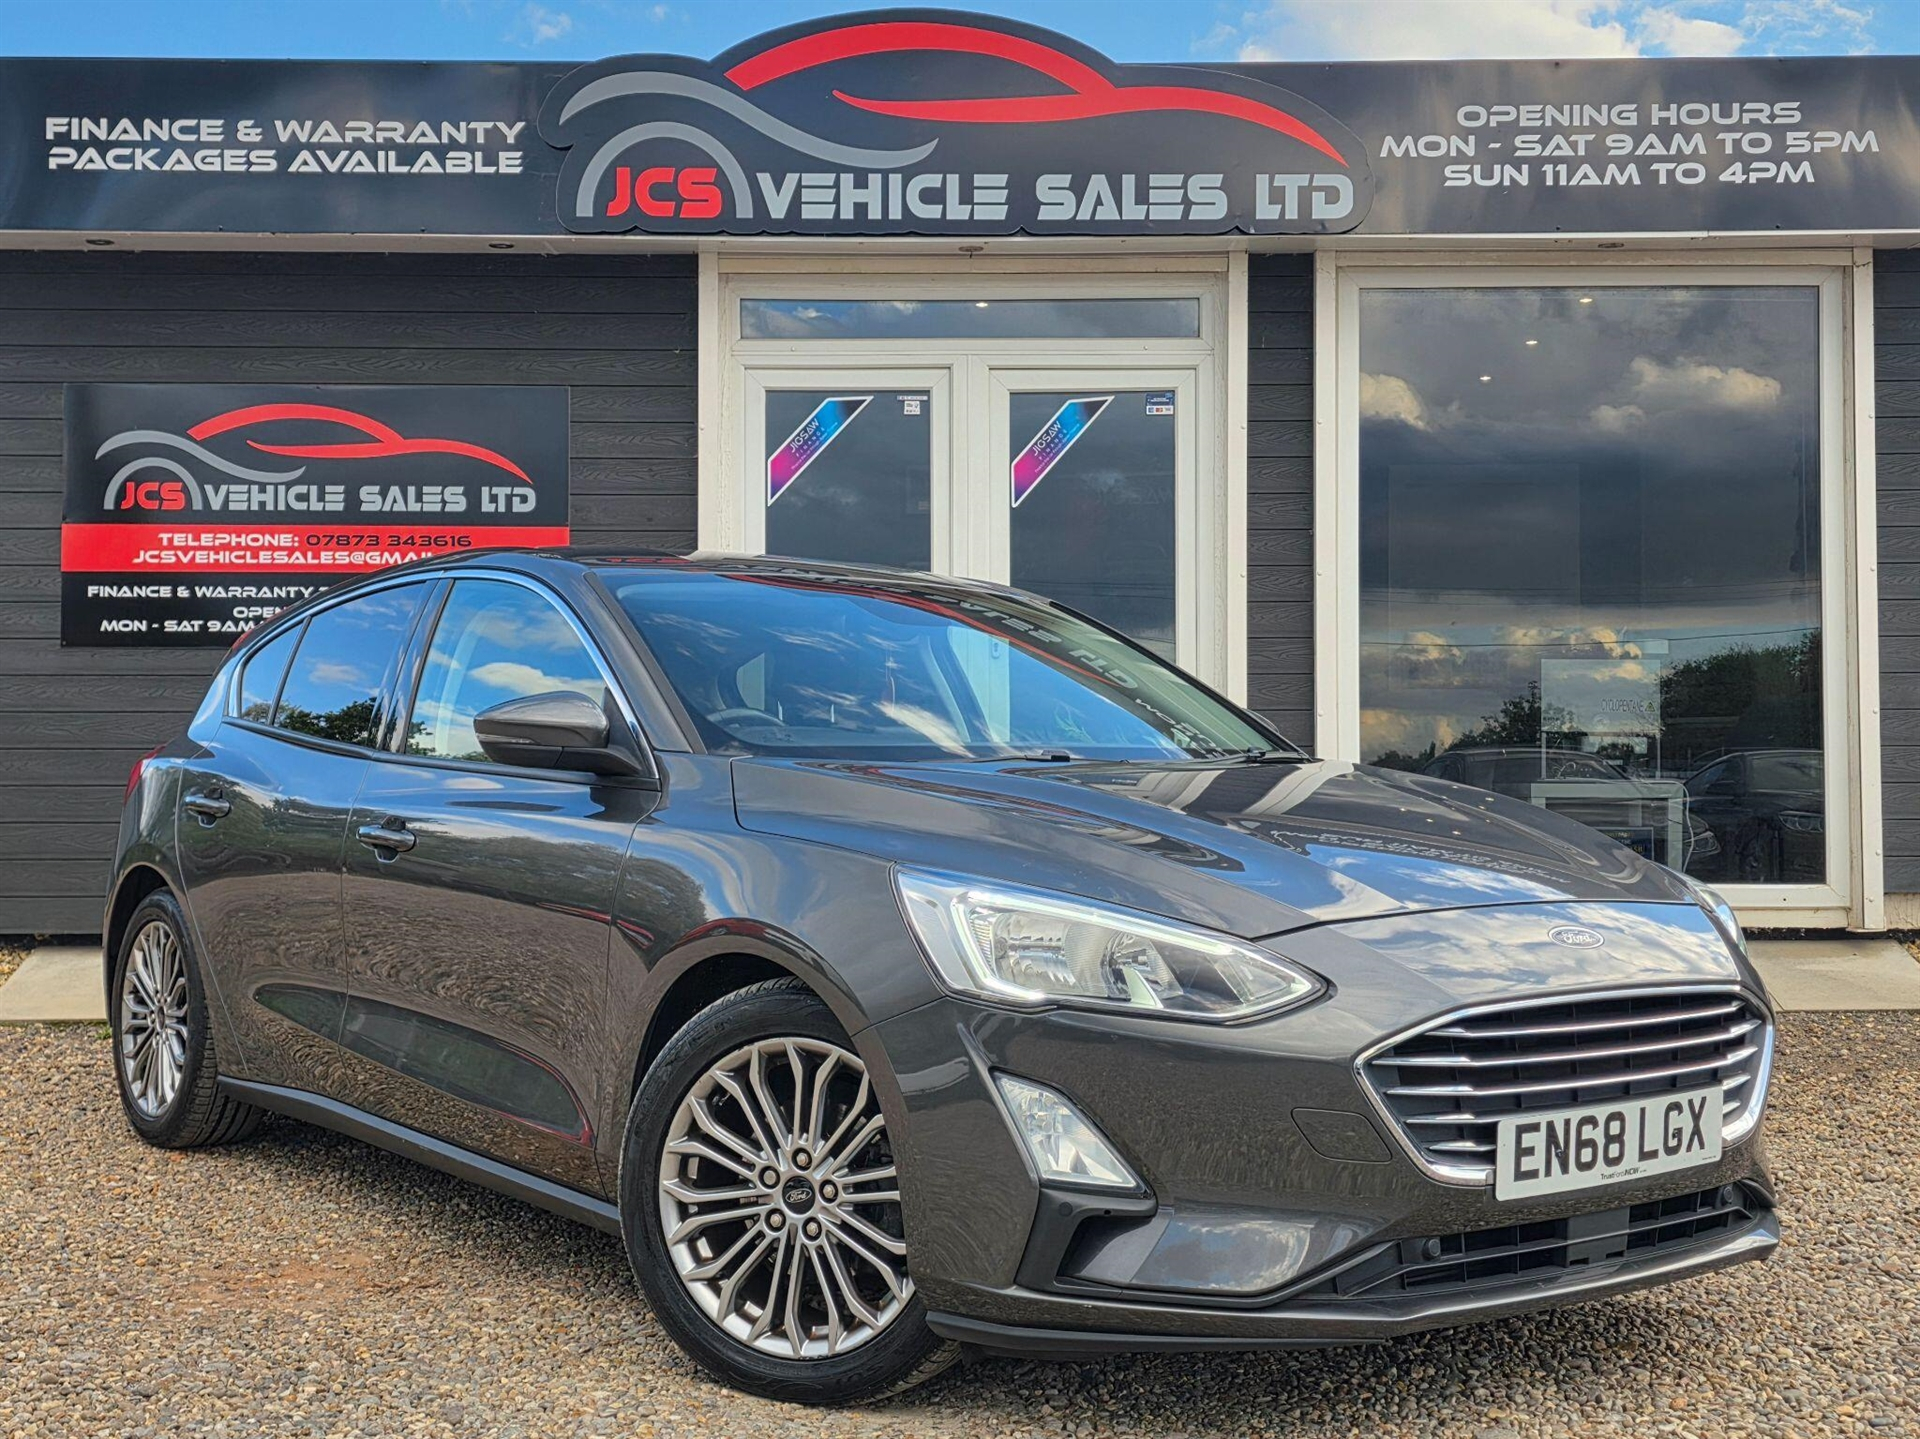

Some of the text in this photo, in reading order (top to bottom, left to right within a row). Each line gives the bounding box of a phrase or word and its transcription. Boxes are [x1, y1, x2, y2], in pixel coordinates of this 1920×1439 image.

[1457, 101, 1802, 128] OPENING HOURS
[45, 117, 526, 144] FINANCE & WARRANTY
[1379, 135, 1476, 158] MON
[1513, 133, 1596, 157] SAT
[1605, 133, 1707, 156] 9AM
[1716, 132, 1773, 155] TO
[1785, 130, 1880, 154] 5PM
[48, 147, 524, 174] PACKAGES AVAILABLE
[1443, 160, 1815, 187] SUN 11AM TO 4PM
[606, 166, 1354, 221] JCS VEHICLE SALES LTD
[789, 417, 820, 453] JIGSAW
[1032, 420, 1063, 456] JIGSAW
[120, 481, 537, 513] JCS VEHICLE SALES LTD
[158, 532, 473, 547] TELEPHONE: 07873 343616
[87, 586, 173, 598] FINANCE
[176, 586, 190, 598] &
[194, 586, 314, 598] WARRANTY
[100, 619, 148, 632] MON
[163, 619, 204, 632] SAT
[206, 619, 255, 632] 9AM
[1513, 1096, 1707, 1183] EN68 LGX
